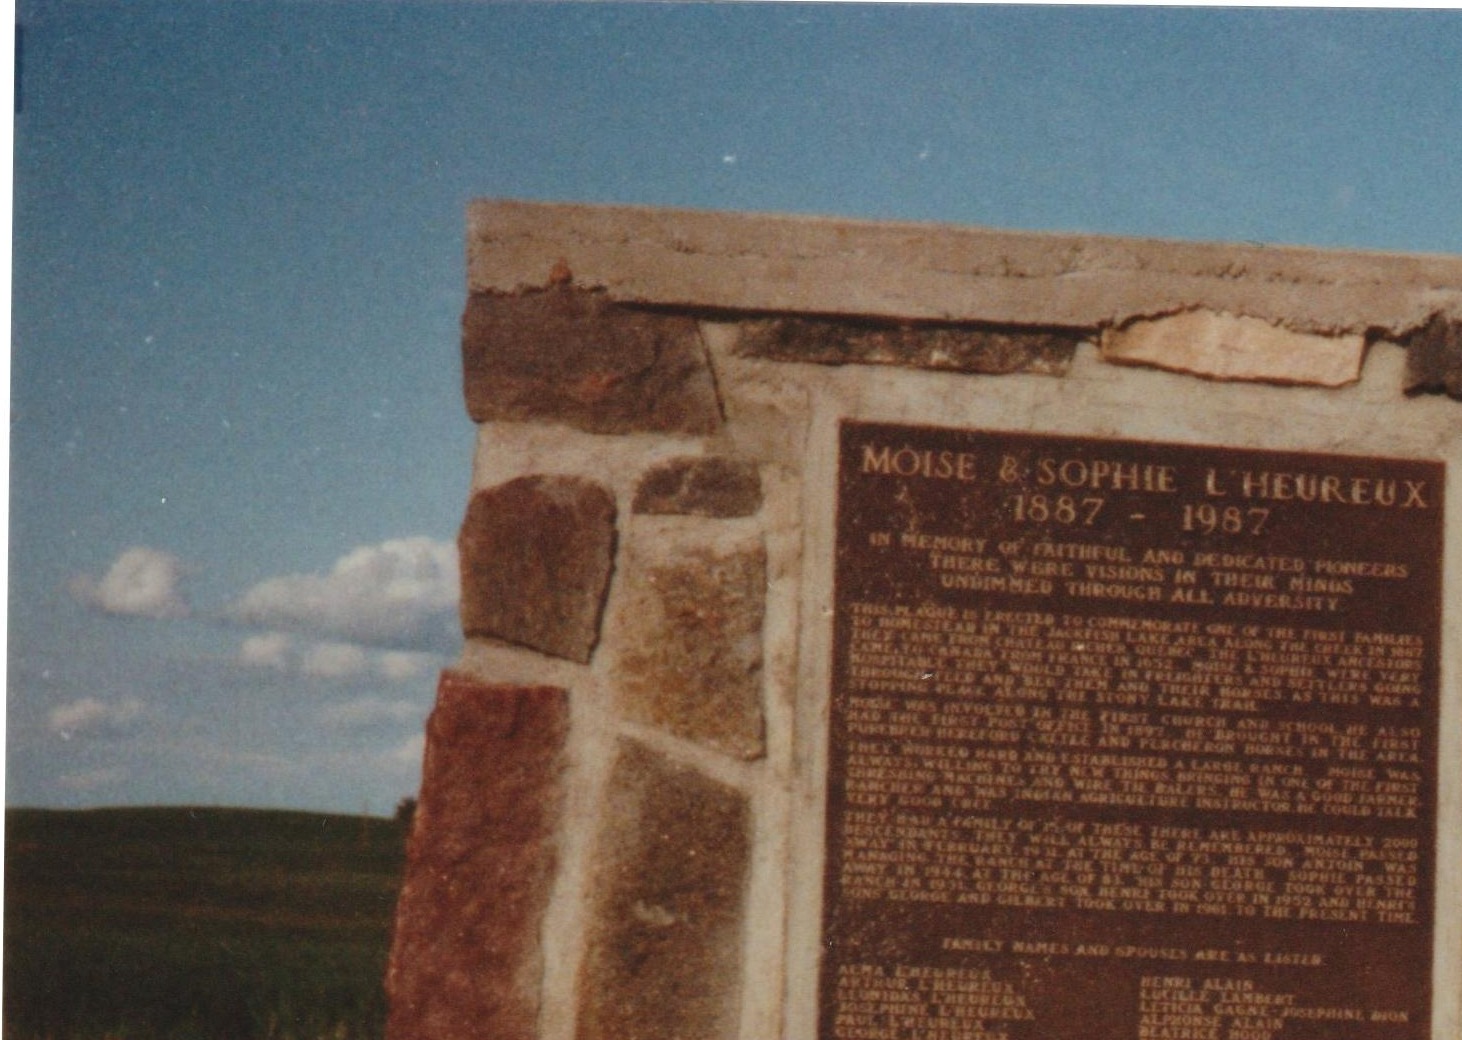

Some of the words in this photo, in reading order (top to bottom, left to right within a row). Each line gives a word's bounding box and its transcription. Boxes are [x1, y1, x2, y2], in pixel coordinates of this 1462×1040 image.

[861, 443, 976, 480] MOISE
[998, 453, 1017, 483] &
[1037, 455, 1178, 494] SOPHIE
[1206, 467, 1428, 510] L'HEUREUX
[1011, 491, 1104, 527] 1887
[1181, 502, 1270, 537] 1987
[868, 530, 889, 547] IN
[902, 532, 984, 552] MEMORY
[998, 538, 1021, 555] OF
[1033, 540, 1130, 562] FAITHFUL
[1143, 547, 1184, 565] AND
[1194, 551, 1304, 572] DEDICATED
[1314, 558, 1409, 579] PIONEERS
[928, 553, 999, 572] THERE
[1012, 558, 1074, 577] WERE
[1085, 563, 1164, 582] VISIONS
[1173, 568, 1197, 584] IN
[1211, 570, 1275, 589] THEIR
[1289, 575, 1353, 594] MINDS
[941, 573, 1051, 594] UNDIMMED
[1067, 581, 1161, 601] THROUGH
[1170, 587, 1213, 604] ALL
[1223, 590, 1339, 611] ADVERSITY
[894, 604, 959, 619] PLAQUE
[962, 608, 978, 620] IS
[985, 609, 1054, 625] ERECTED
[1062, 614, 1083, 627] TO
[1087, 616, 1199, 633] COMMEMORATE
[1206, 623, 1235, 635] ONE
[1242, 625, 1260, 637] OF
[1267, 626, 1295, 639] THE
[1304, 629, 1345, 642] FIRST
[1355, 632, 1423, 647] FAMILIES
[942, 938, 1003, 951] FAMILY
[1012, 941, 1069, 954] NAMES
[1074, 943, 1109, 956] AND
[1114, 945, 1188, 959] SPOUSES
[1195, 949, 1229, 961] ARE
[1237, 951, 1255, 962] AS
